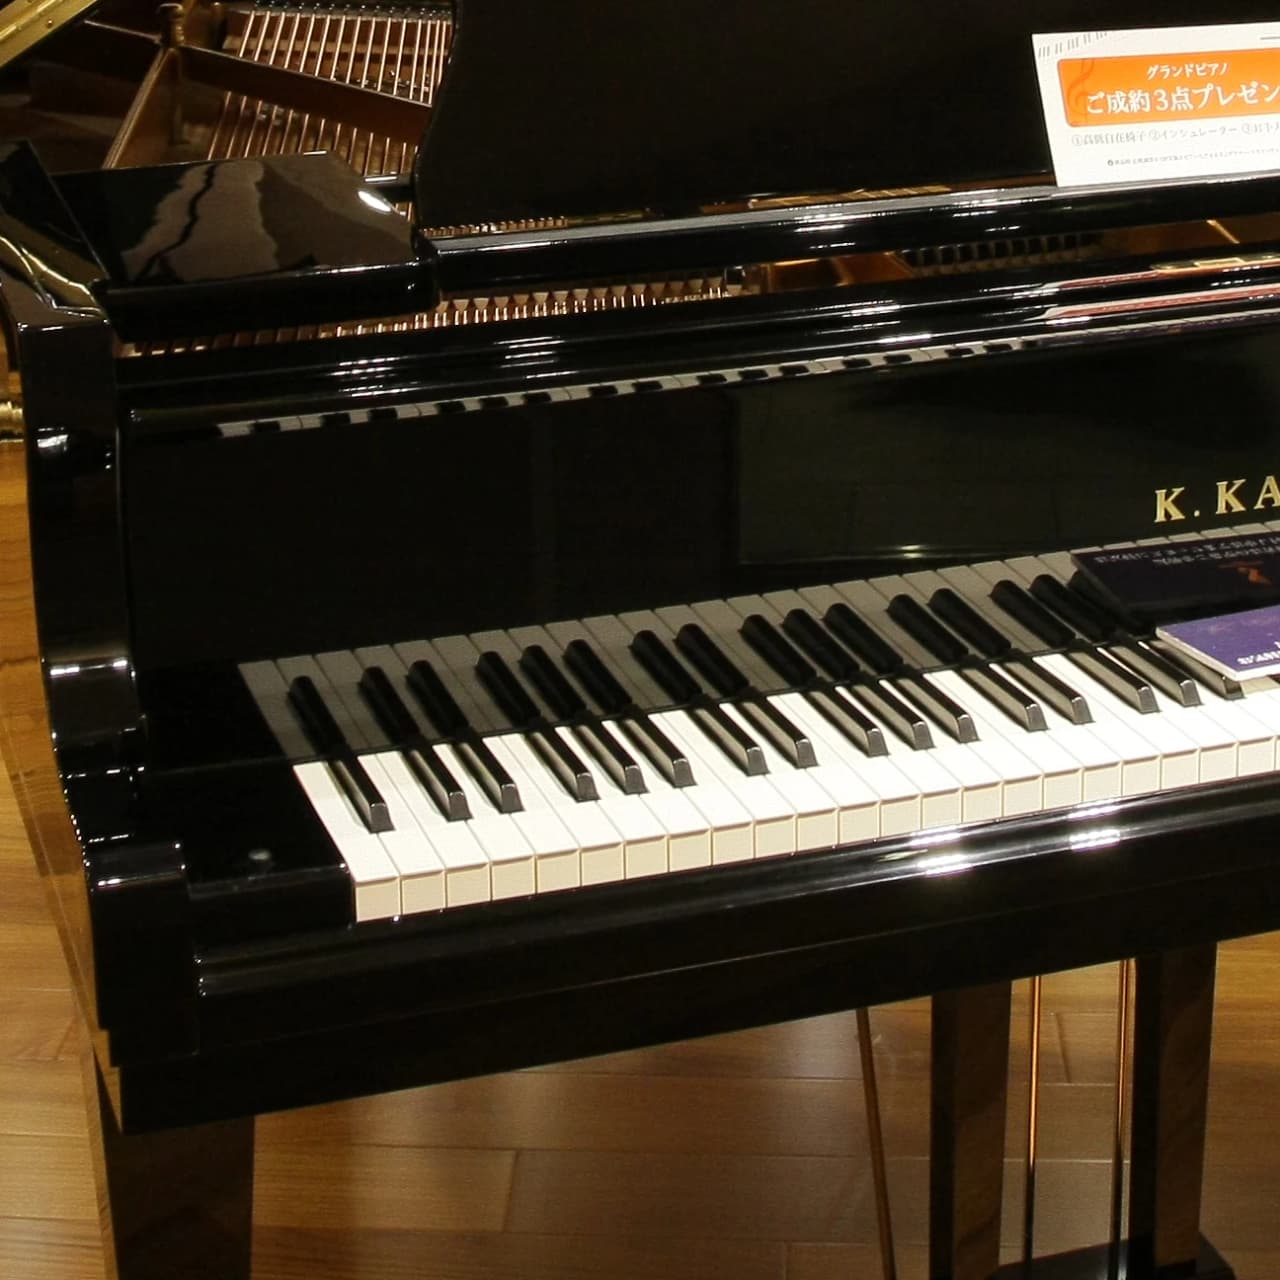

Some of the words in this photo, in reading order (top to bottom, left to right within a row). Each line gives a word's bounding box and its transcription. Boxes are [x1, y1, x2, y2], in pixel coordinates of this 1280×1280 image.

[1146, 62, 1231, 81] グランドピアノ
